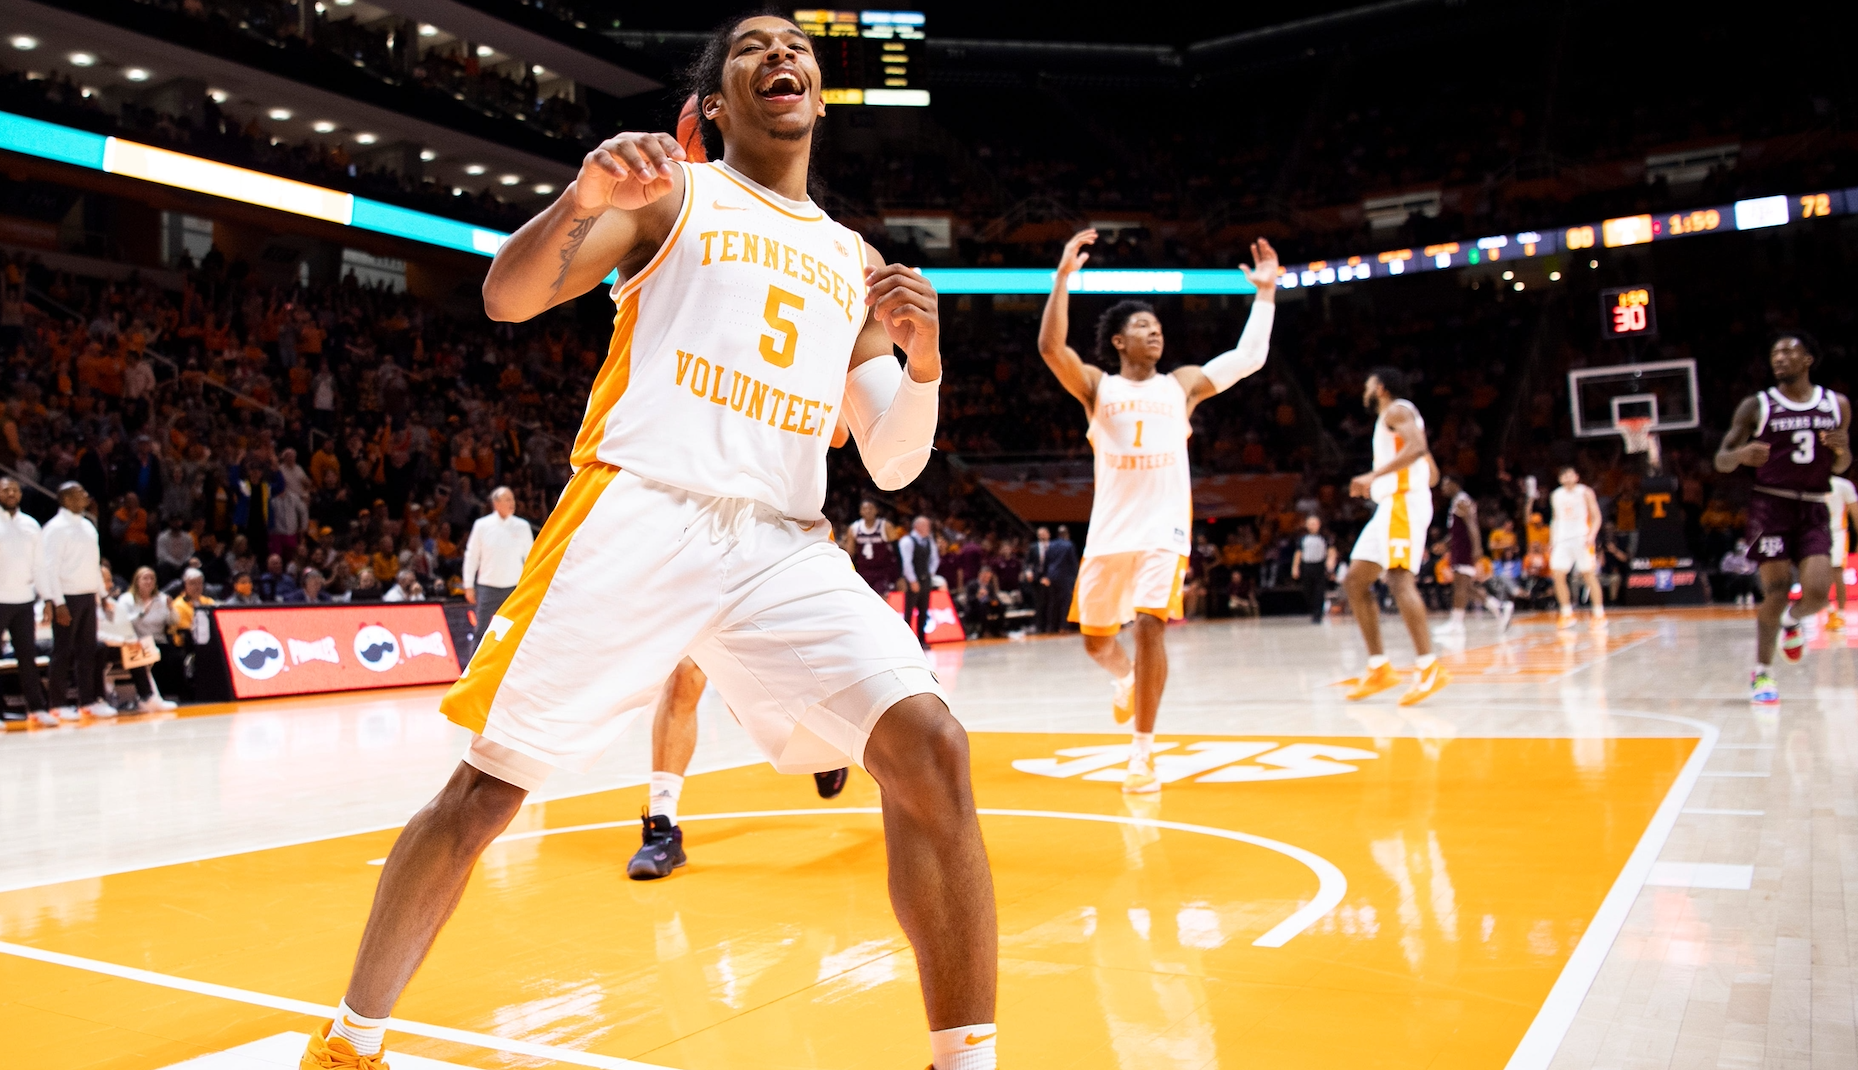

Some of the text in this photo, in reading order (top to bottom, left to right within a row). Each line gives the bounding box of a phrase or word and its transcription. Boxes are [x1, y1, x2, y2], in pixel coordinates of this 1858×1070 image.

[1668, 209, 1720, 235] 1:59
[1800, 193, 1831, 218] 72
[700, 230, 857, 324] TENNESSEE
[758, 284, 805, 369] 5
[1612, 304, 1646, 332] 30
[1133, 420, 1143, 447] 1
[1791, 430, 1815, 464] 3
[1644, 493, 1671, 518] T
[1390, 538, 1410, 558] T
